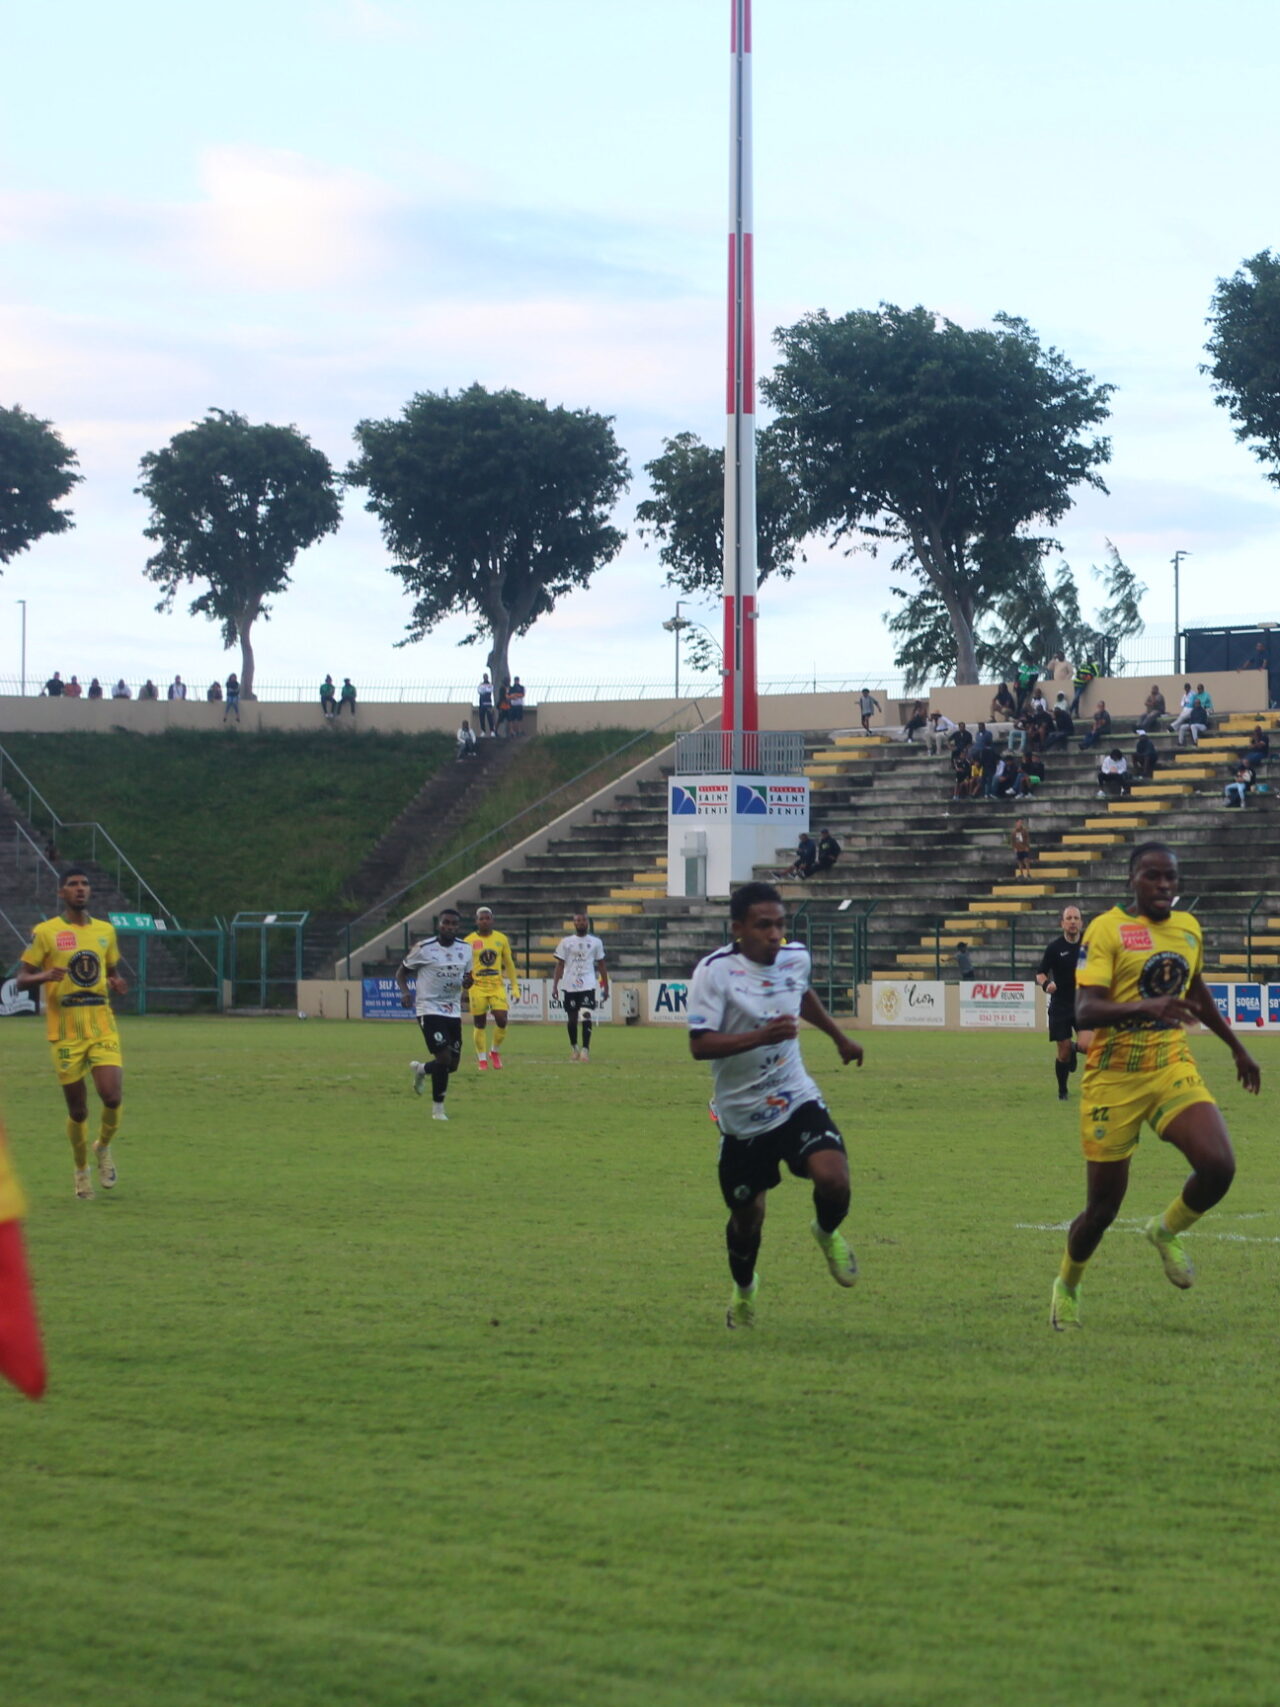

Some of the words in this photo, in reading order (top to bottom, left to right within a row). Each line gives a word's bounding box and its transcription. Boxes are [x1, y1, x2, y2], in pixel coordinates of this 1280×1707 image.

[699, 793, 728, 801] SAINT
[769, 794, 805, 802] SAINT
[699, 807, 728, 815] DENIS
[769, 807, 805, 815] DENIS
[379, 980, 393, 990] SELF
[971, 983, 1002, 999] PLV
[1236, 997, 1260, 1007] SOGEA
